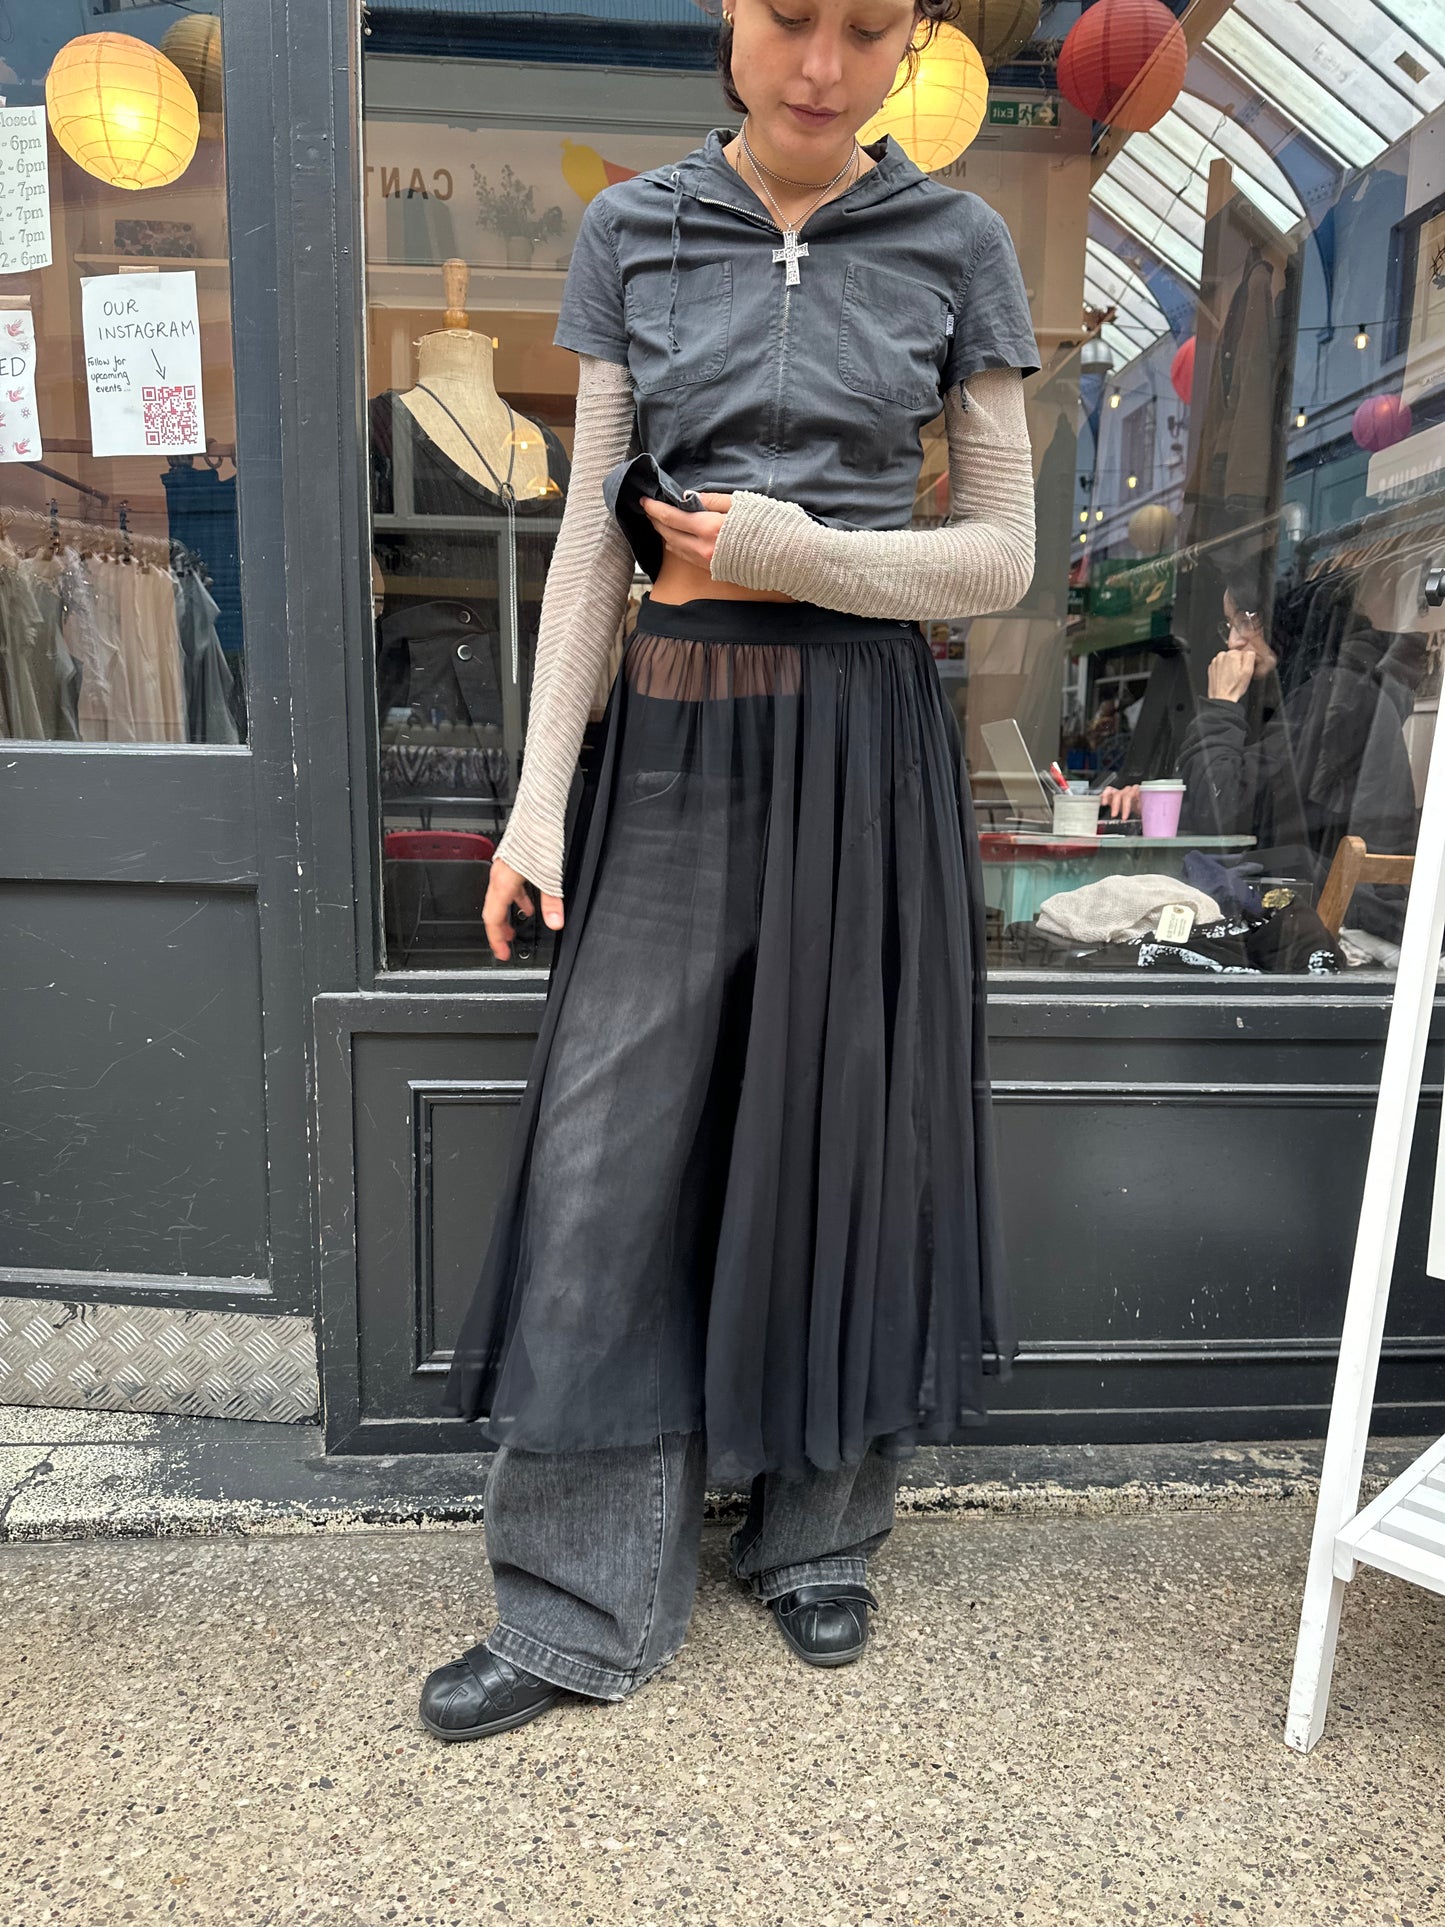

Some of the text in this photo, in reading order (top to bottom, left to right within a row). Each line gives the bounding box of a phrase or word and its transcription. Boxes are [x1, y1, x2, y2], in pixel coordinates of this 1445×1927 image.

[0, 110, 37, 127] losed
[10, 135, 42, 154] 6pm
[17, 158, 46, 178] 6pm
[17, 182, 46, 200] 7pm
[16, 206, 44, 224] 7pm
[18, 229, 45, 247] 7pm
[21, 251, 48, 270] 6pm
[103, 299, 139, 316] OUR
[98, 319, 195, 341] INSTAGRAM
[87, 356, 126, 372] Follow for
[90, 371, 131, 386] upcoming
